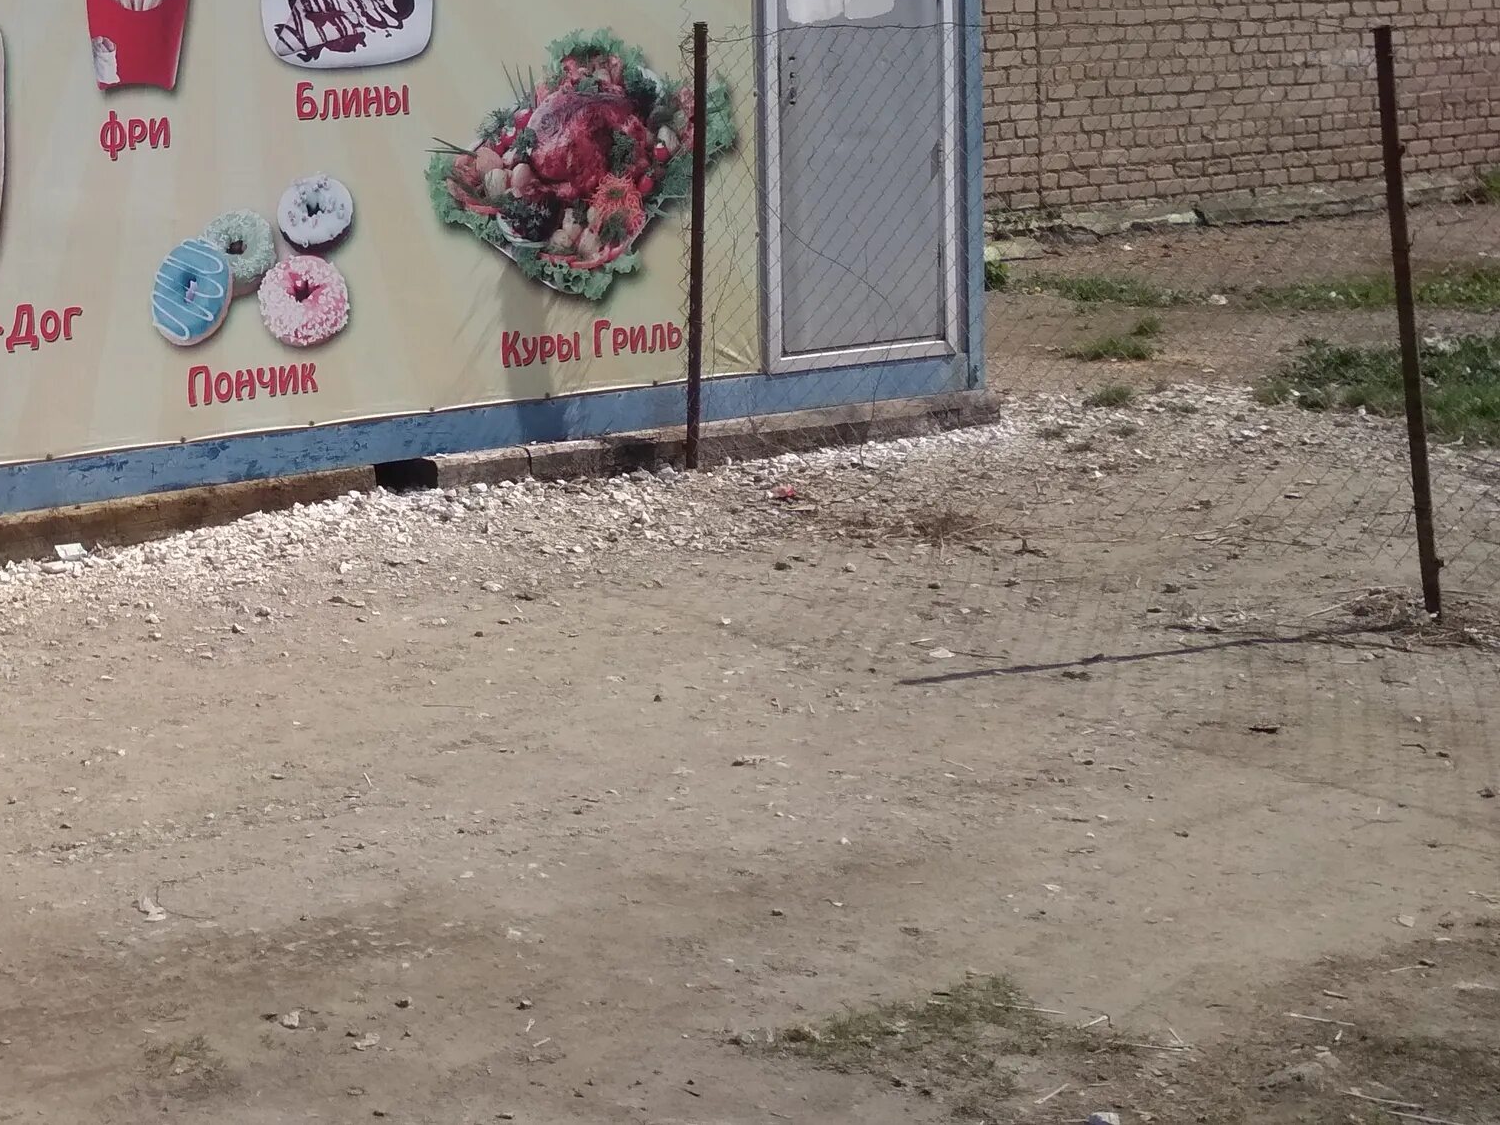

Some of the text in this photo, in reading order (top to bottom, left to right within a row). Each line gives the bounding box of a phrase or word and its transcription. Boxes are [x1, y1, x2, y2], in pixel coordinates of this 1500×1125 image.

[295, 80, 410, 121] Блины
[100, 110, 172, 162] фри
[501, 320, 683, 368] Куры Гриль
[187, 361, 319, 408] Пончик
